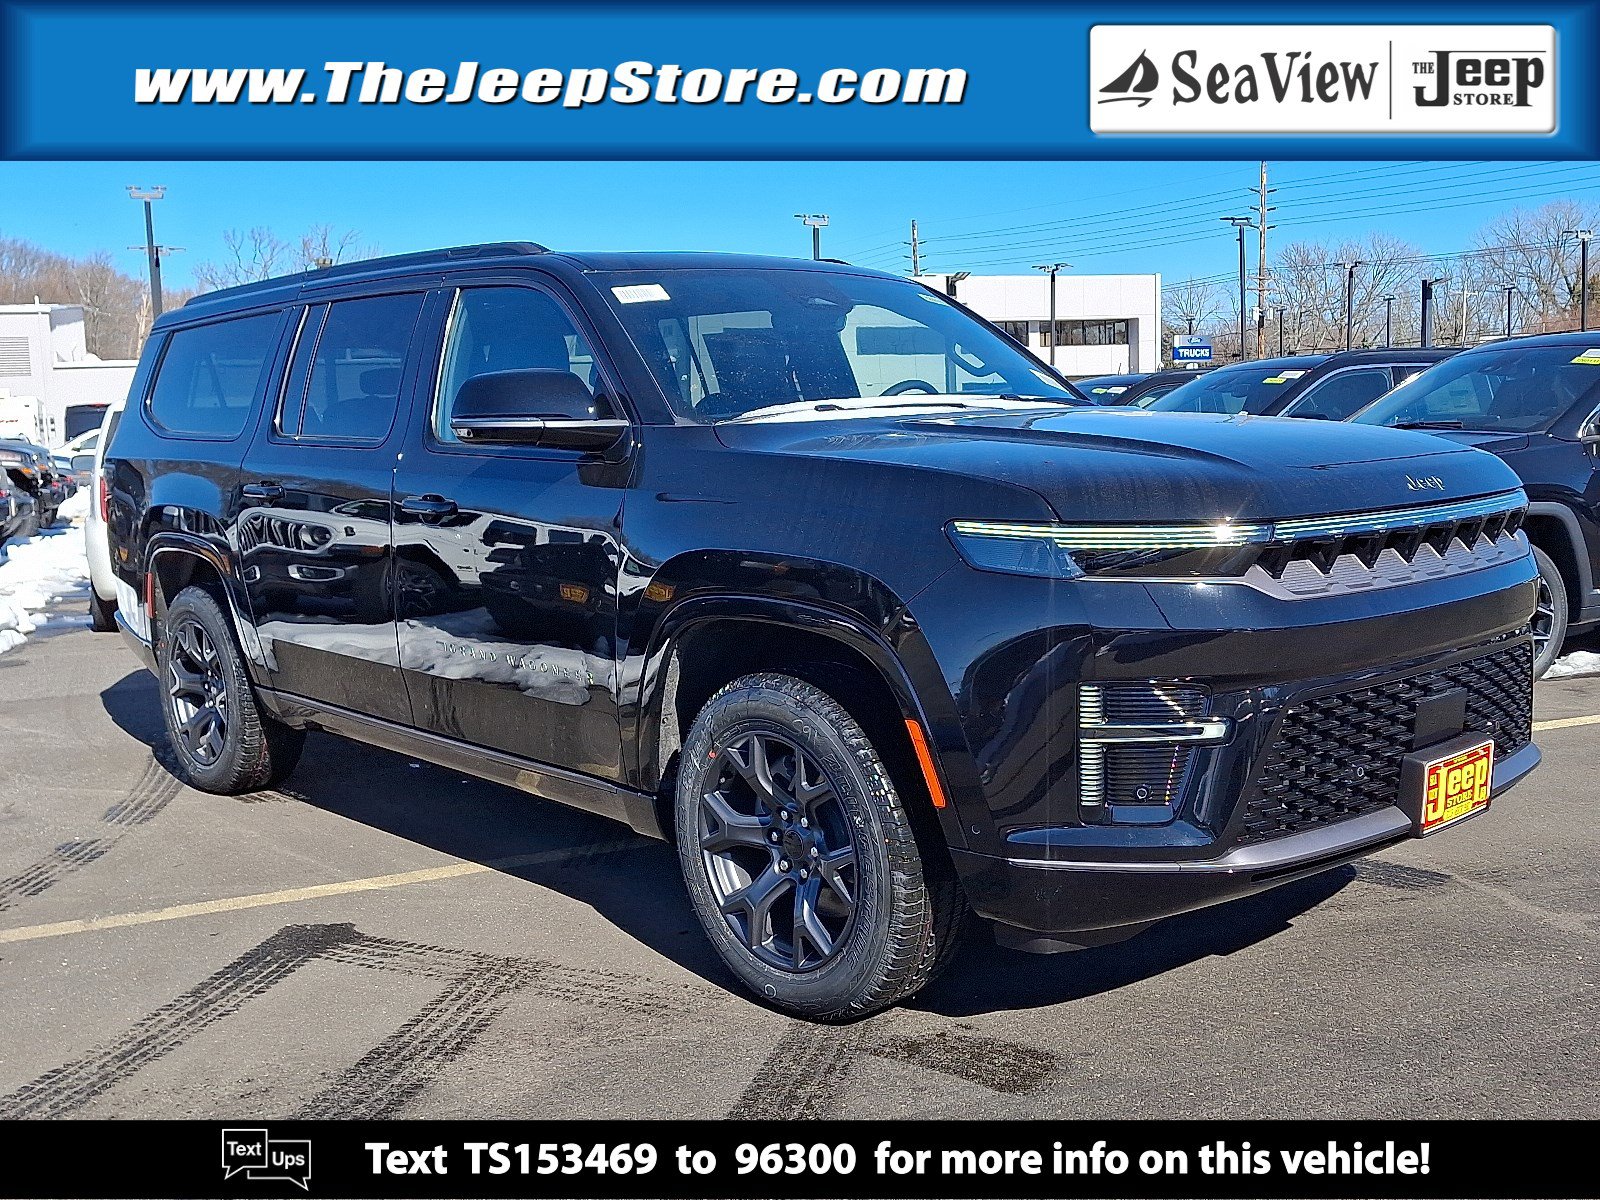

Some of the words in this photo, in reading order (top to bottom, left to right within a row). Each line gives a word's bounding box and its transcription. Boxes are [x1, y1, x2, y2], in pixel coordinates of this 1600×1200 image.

[1178, 348, 1210, 358] TRUCKS
[1405, 474, 1446, 491] Jeep
[1427, 756, 1489, 822] Jeep
[1446, 789, 1473, 808] STORE
